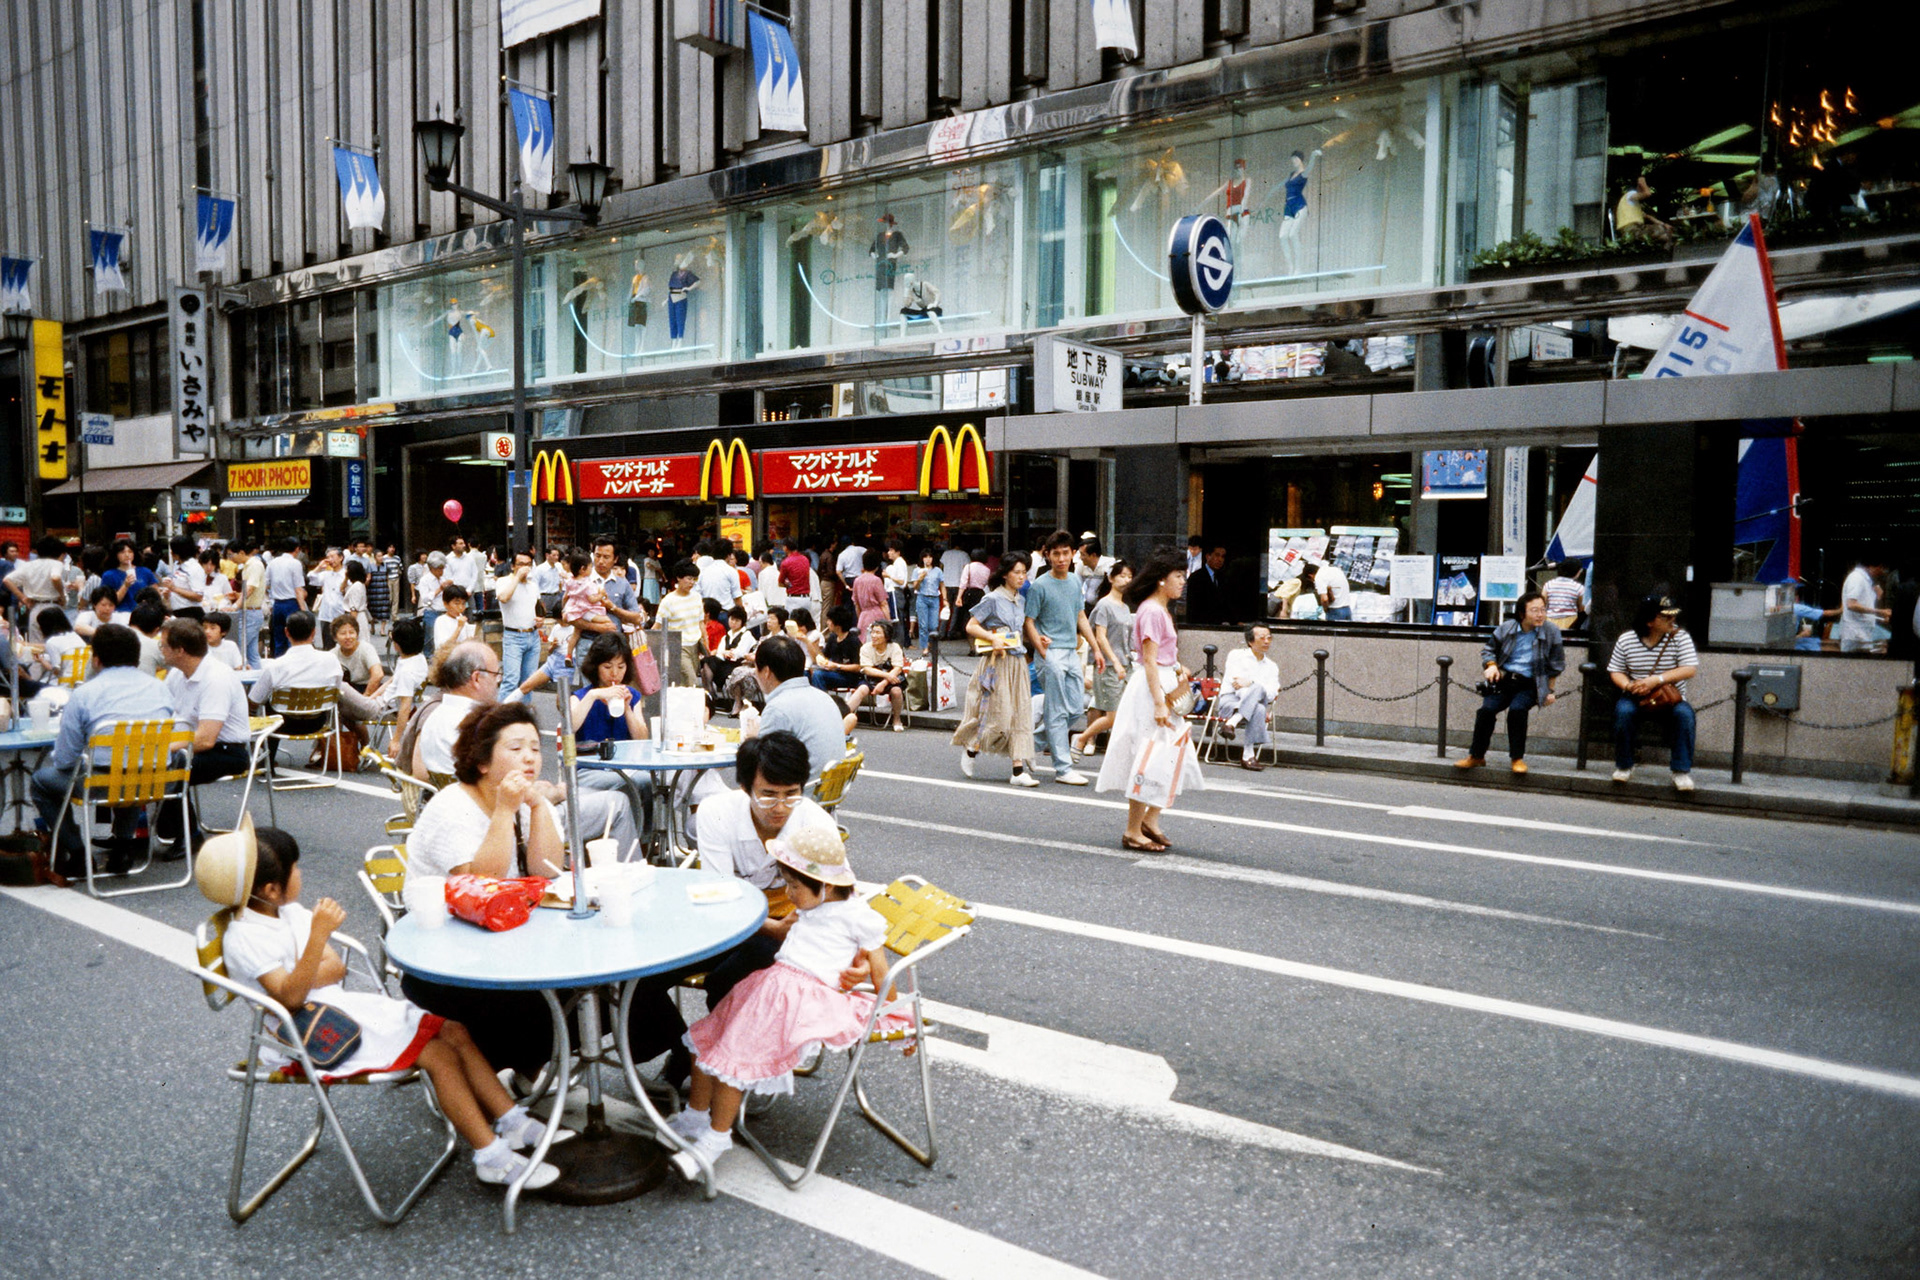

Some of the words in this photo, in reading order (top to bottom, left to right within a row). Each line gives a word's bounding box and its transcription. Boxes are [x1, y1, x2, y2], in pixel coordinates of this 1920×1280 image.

[1067, 347, 1107, 376] 地下鉄
[1071, 371, 1104, 389] SUBWAY
[179, 350, 205, 443] いさみや
[600, 460, 671, 478] マクドナルド
[789, 449, 880, 470] マクドナルド
[230, 470, 237, 488] 7
[239, 468, 267, 488] HOUR
[268, 466, 309, 487] PHOTO
[604, 478, 674, 495] ハンバーガー
[793, 470, 884, 489] ハンバーガー
[350, 474, 362, 506] 地下鉄
